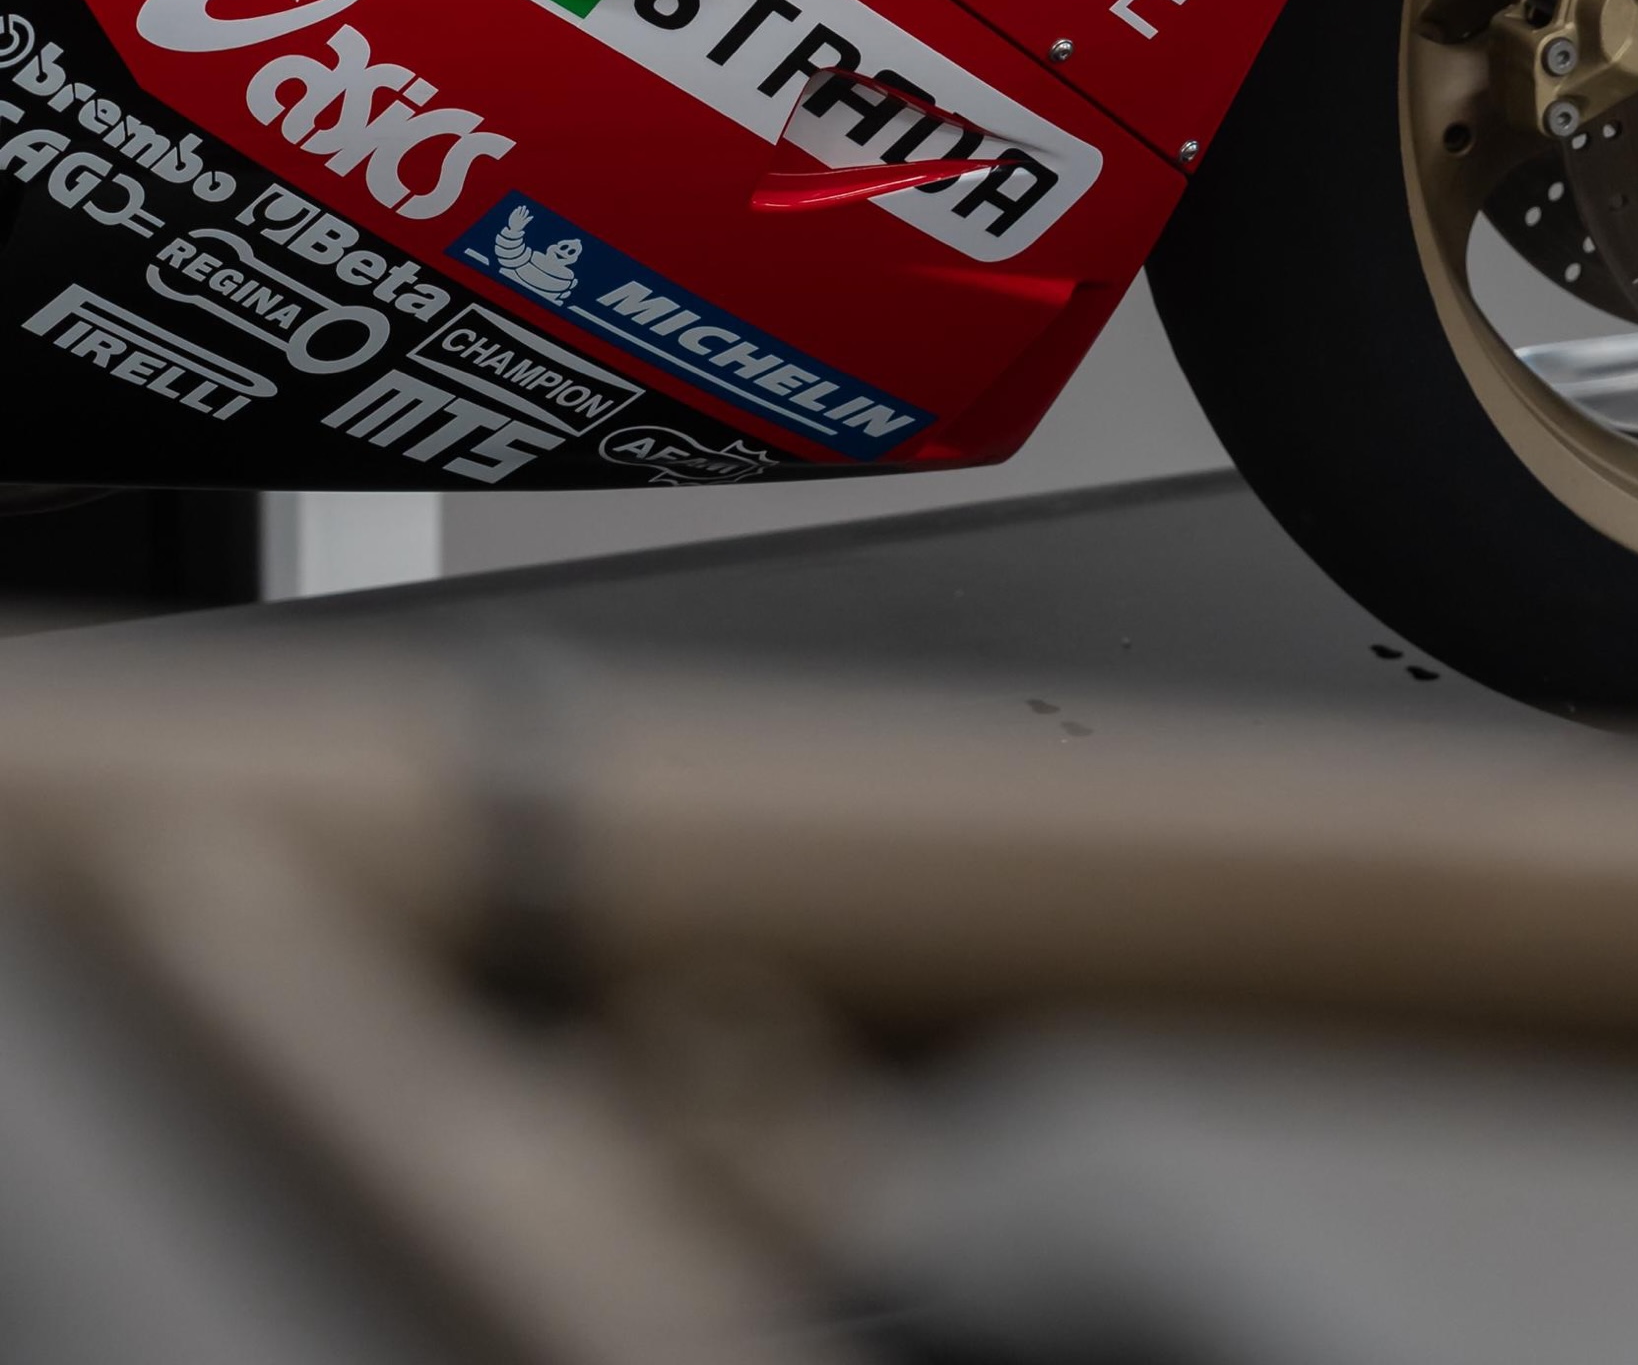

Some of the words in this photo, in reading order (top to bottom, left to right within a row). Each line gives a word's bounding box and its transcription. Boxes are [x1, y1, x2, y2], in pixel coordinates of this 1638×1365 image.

[12, 41, 236, 202] brembo
[157, 237, 302, 329] REGINA
[287, 213, 450, 322] Beta
[21, 283, 278, 420] PIRELLI
[441, 328, 614, 419] CHAMPION
[596, 280, 916, 438] MICHELIN
[320, 369, 567, 484] MTS
